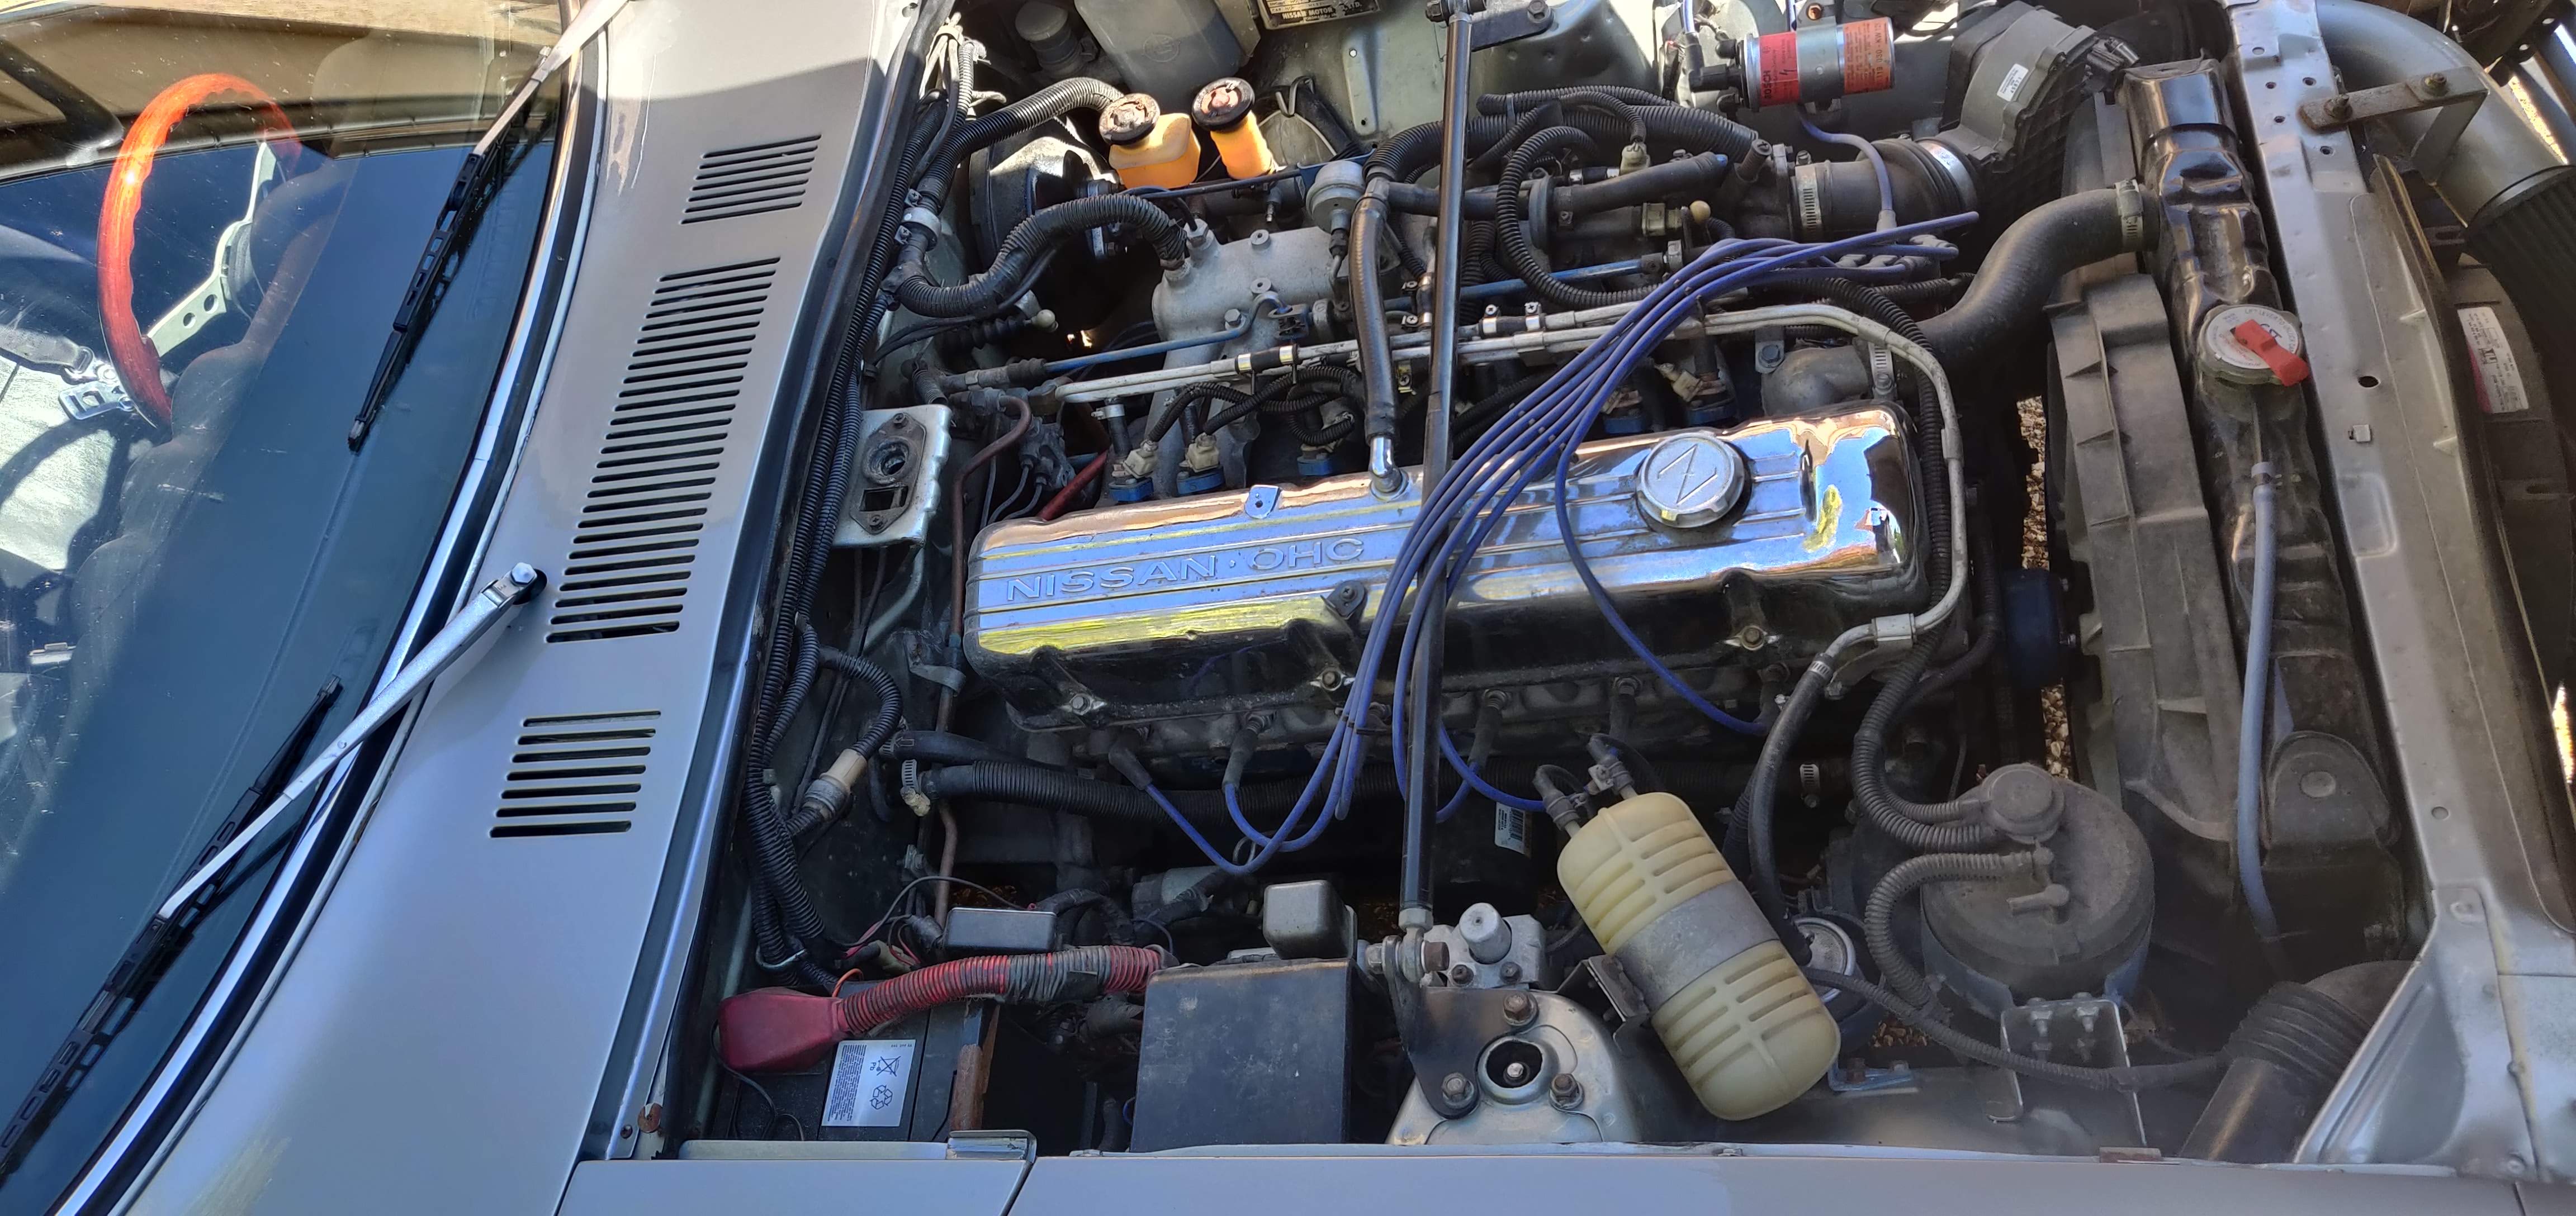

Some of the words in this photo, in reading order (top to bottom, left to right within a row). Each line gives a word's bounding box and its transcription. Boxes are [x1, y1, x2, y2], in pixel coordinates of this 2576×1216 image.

[1282, 10, 1306, 19] NISSAN
[1309, 7, 1333, 16] MOTOR
[1007, 555, 1216, 601] NISSAN
[1248, 538, 1365, 570] OHC
[870, 1062, 877, 1071] Pb
